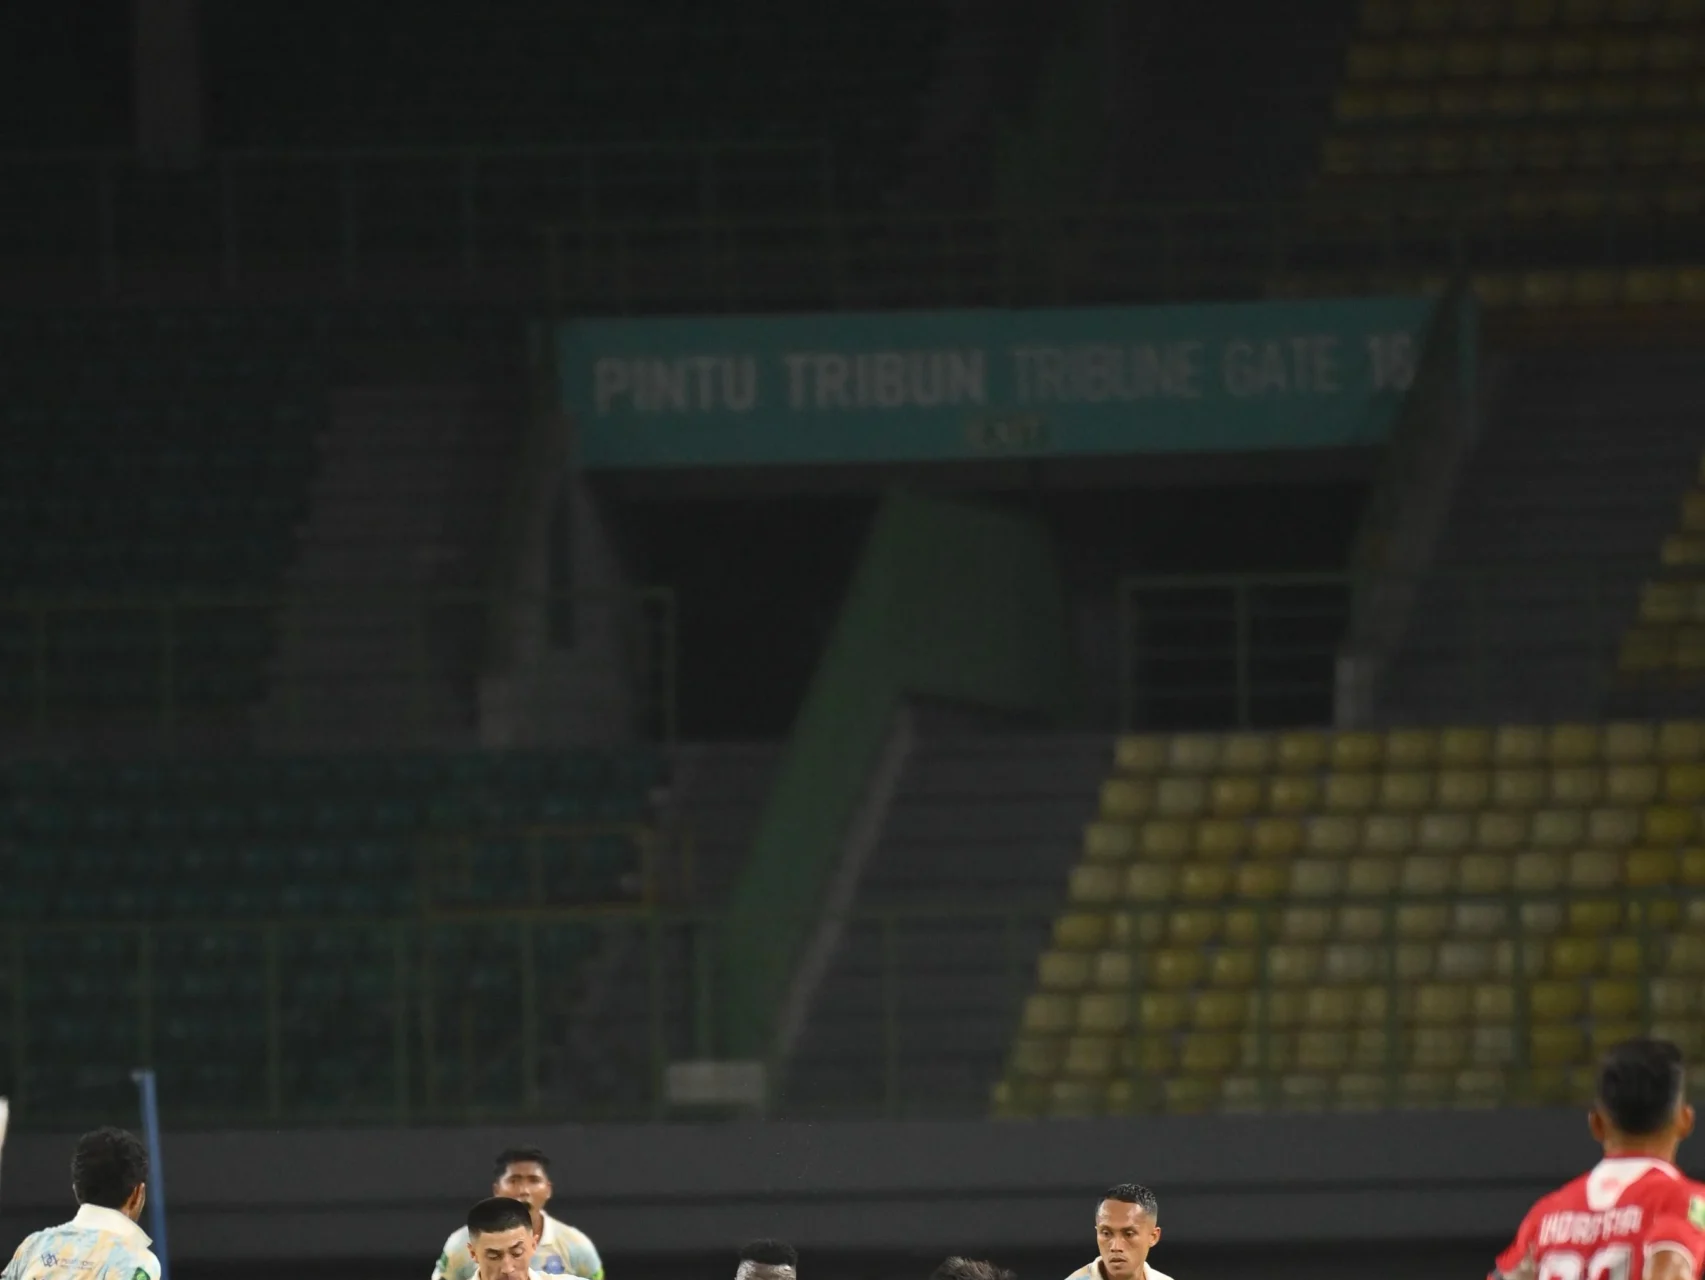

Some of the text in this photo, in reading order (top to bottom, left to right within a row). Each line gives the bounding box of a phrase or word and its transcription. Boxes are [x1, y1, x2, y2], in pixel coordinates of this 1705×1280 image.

[593, 354, 757, 416] PINTU
[782, 347, 986, 410] TRIBUN
[1012, 340, 1202, 404] TRIBUNE
[1223, 335, 1341, 397] GATE
